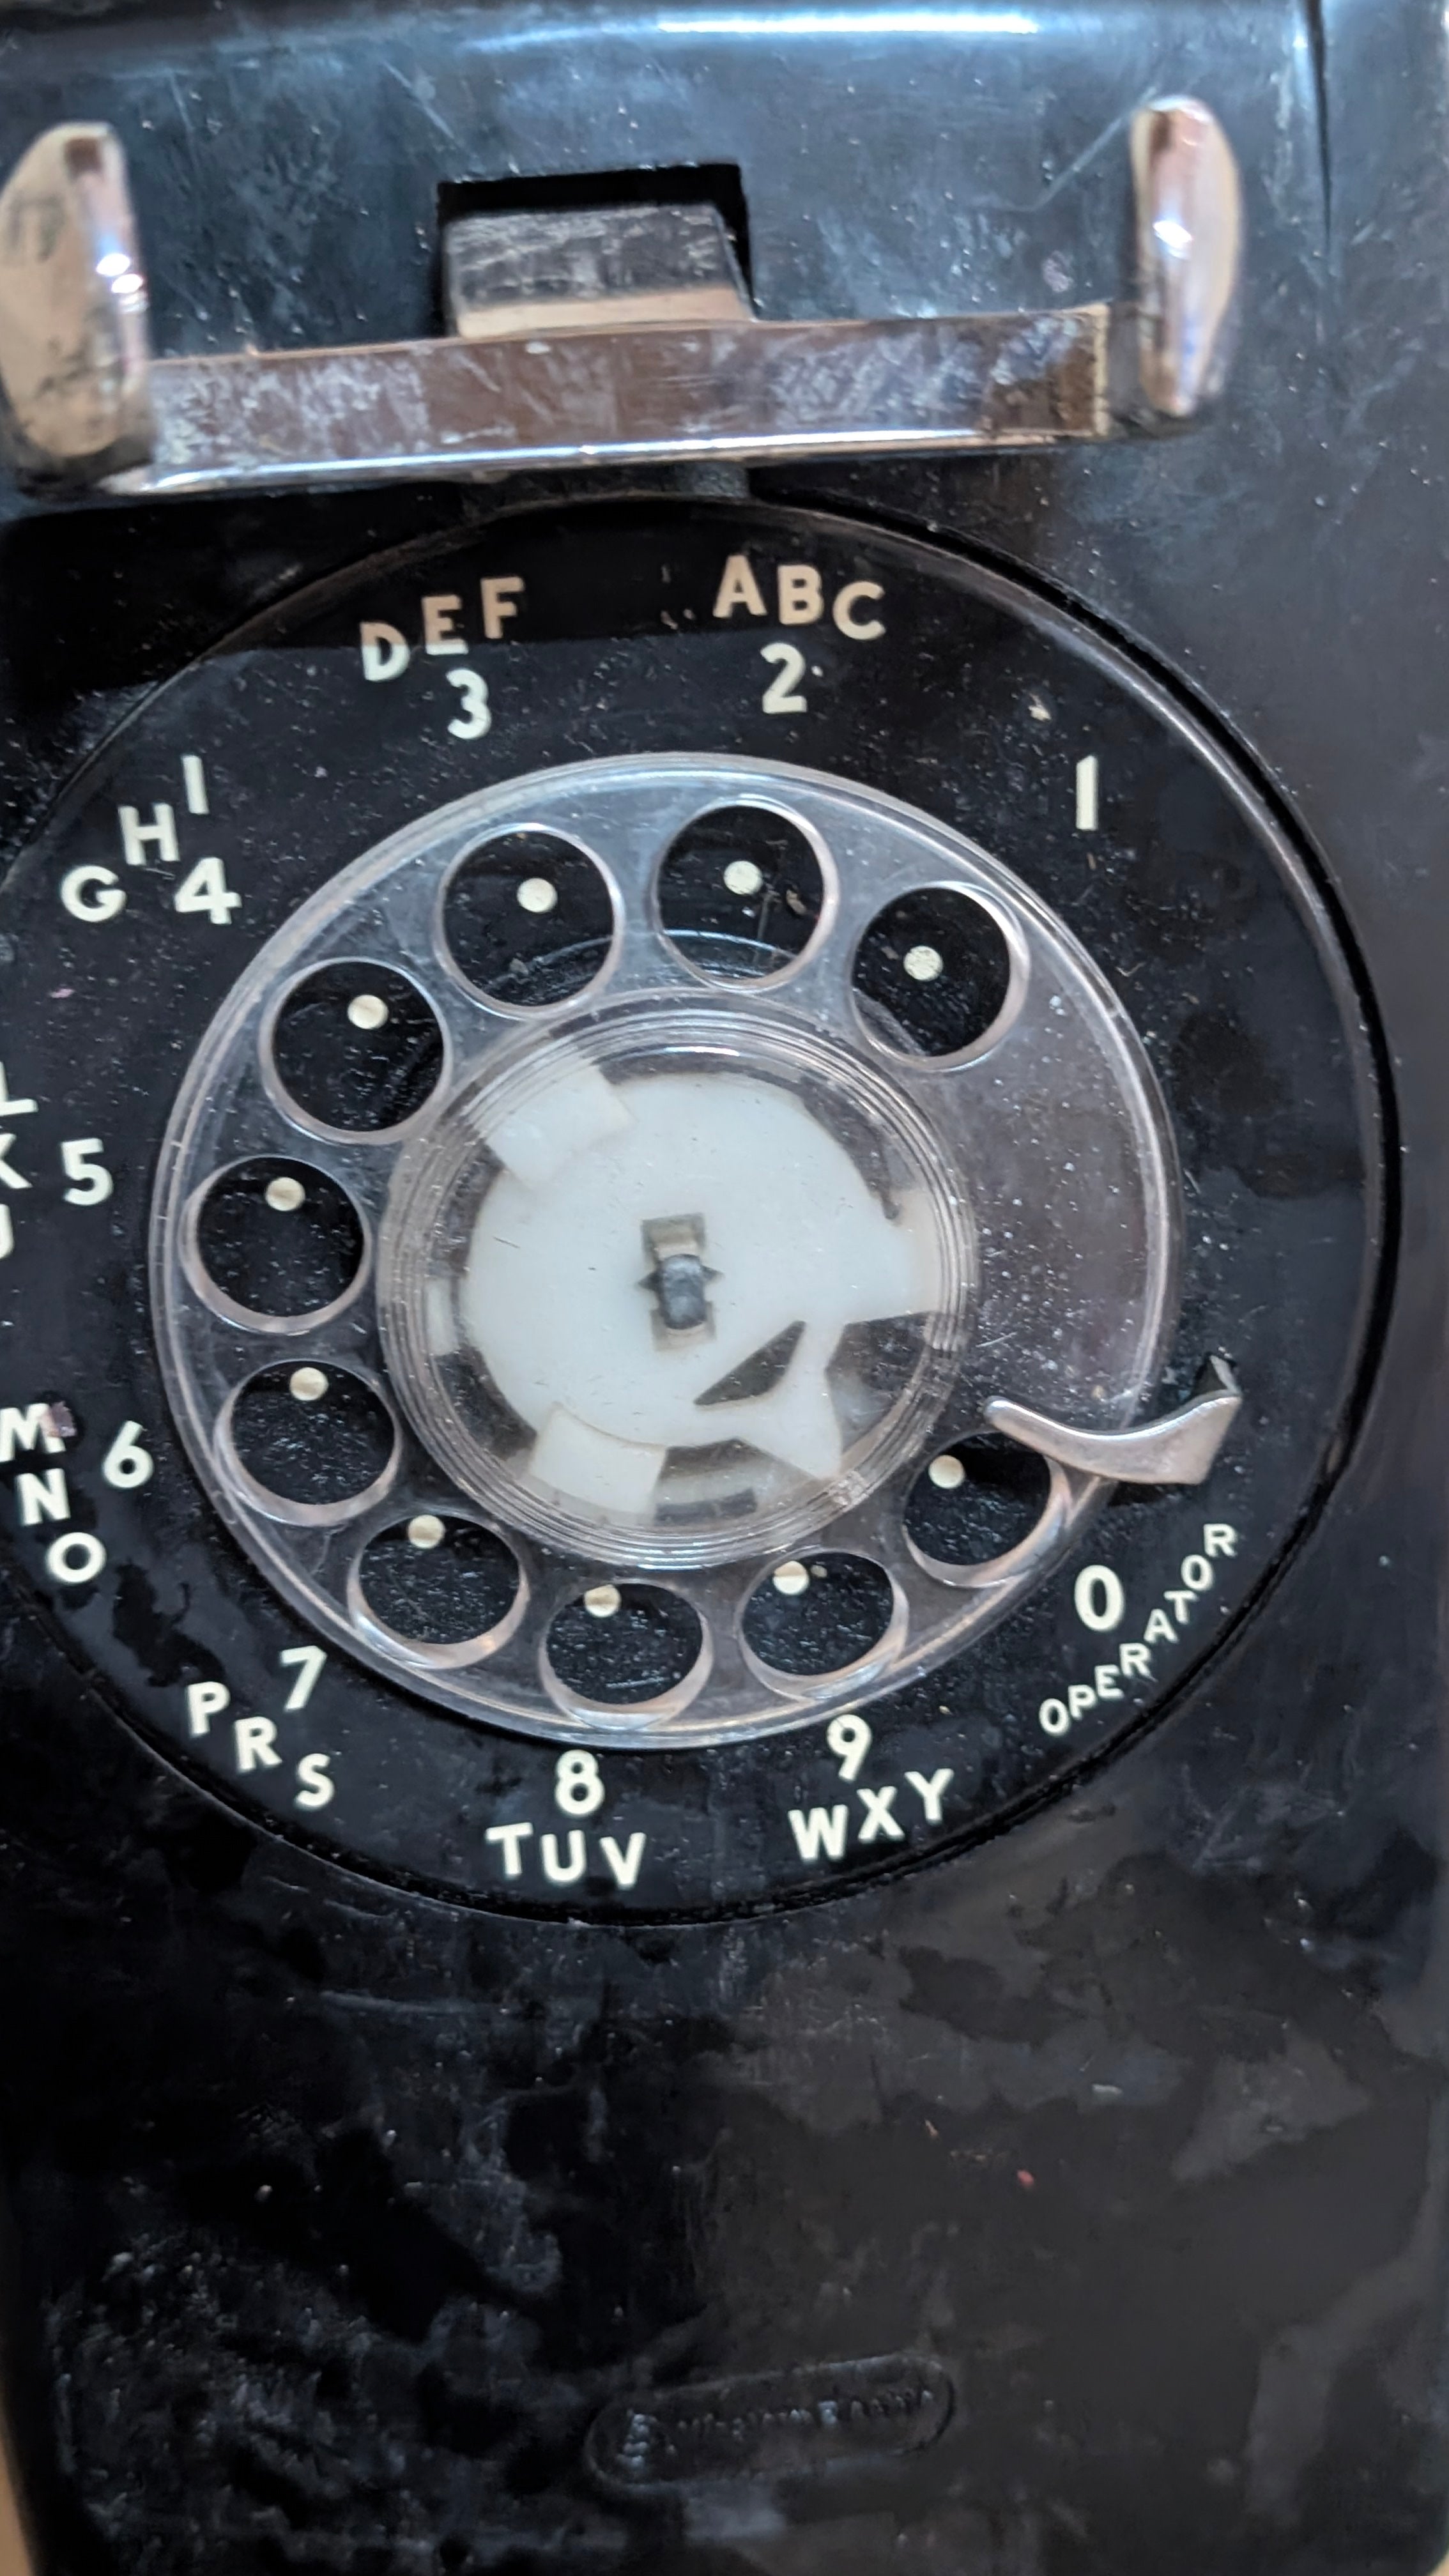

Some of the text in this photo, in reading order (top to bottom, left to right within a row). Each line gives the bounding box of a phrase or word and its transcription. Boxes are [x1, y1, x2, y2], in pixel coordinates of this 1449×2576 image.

[360, 578, 522, 682] DEF
[714, 555, 885, 641] ABC
[445, 668, 493, 740] 3
[760, 641, 807, 714] 2
[1076, 755, 1098, 831] 1
[60, 755, 209, 924] GHI
[173, 856, 241, 925] 4
[61, 1138, 113, 1206] 5
[102, 1420, 154, 1489] 6
[0, 1402, 106, 1584] MNO
[1038, 1522, 1238, 1736] OPERATOR
[280, 1644, 328, 1712] 7
[186, 1680, 335, 1809] PRS
[826, 1713, 873, 1782] 9
[555, 1749, 605, 1817] 8
[787, 1767, 955, 1862] WXY
[484, 1821, 647, 1889] TUV
